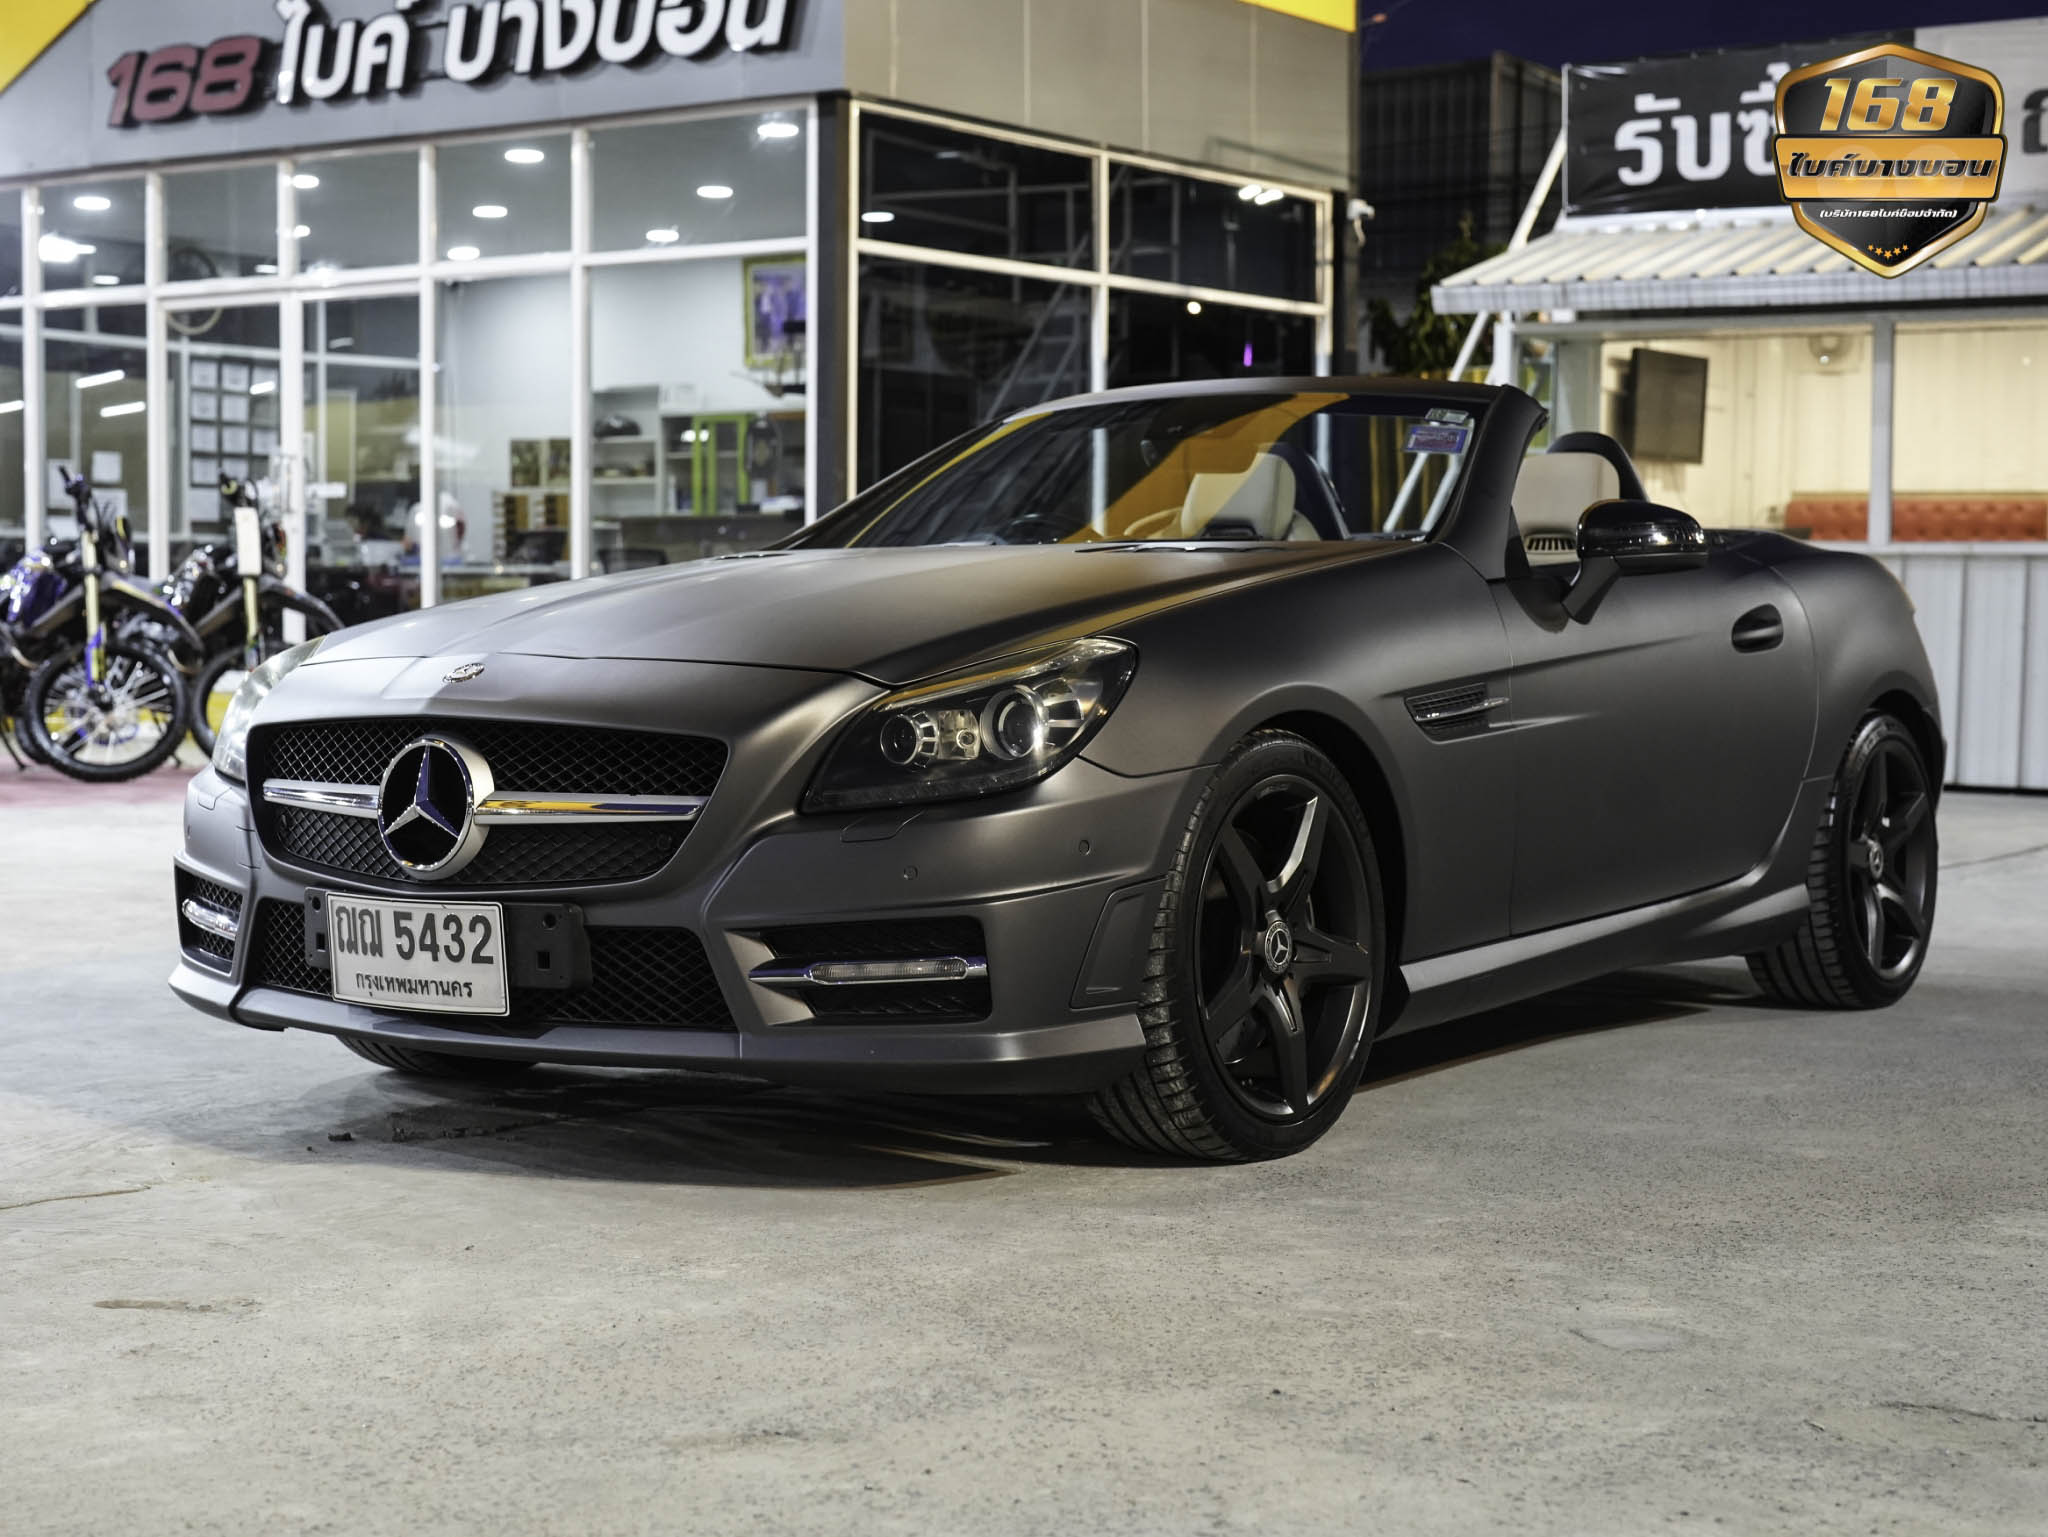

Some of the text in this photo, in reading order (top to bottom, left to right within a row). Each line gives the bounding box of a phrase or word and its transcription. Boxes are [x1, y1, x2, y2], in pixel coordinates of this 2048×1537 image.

[107, 36, 262, 128] 168
[445, 0, 788, 82] บางบอน
[393, 910, 494, 965] 5432
[356, 973, 473, 998] กรุงเทพมหานคร
